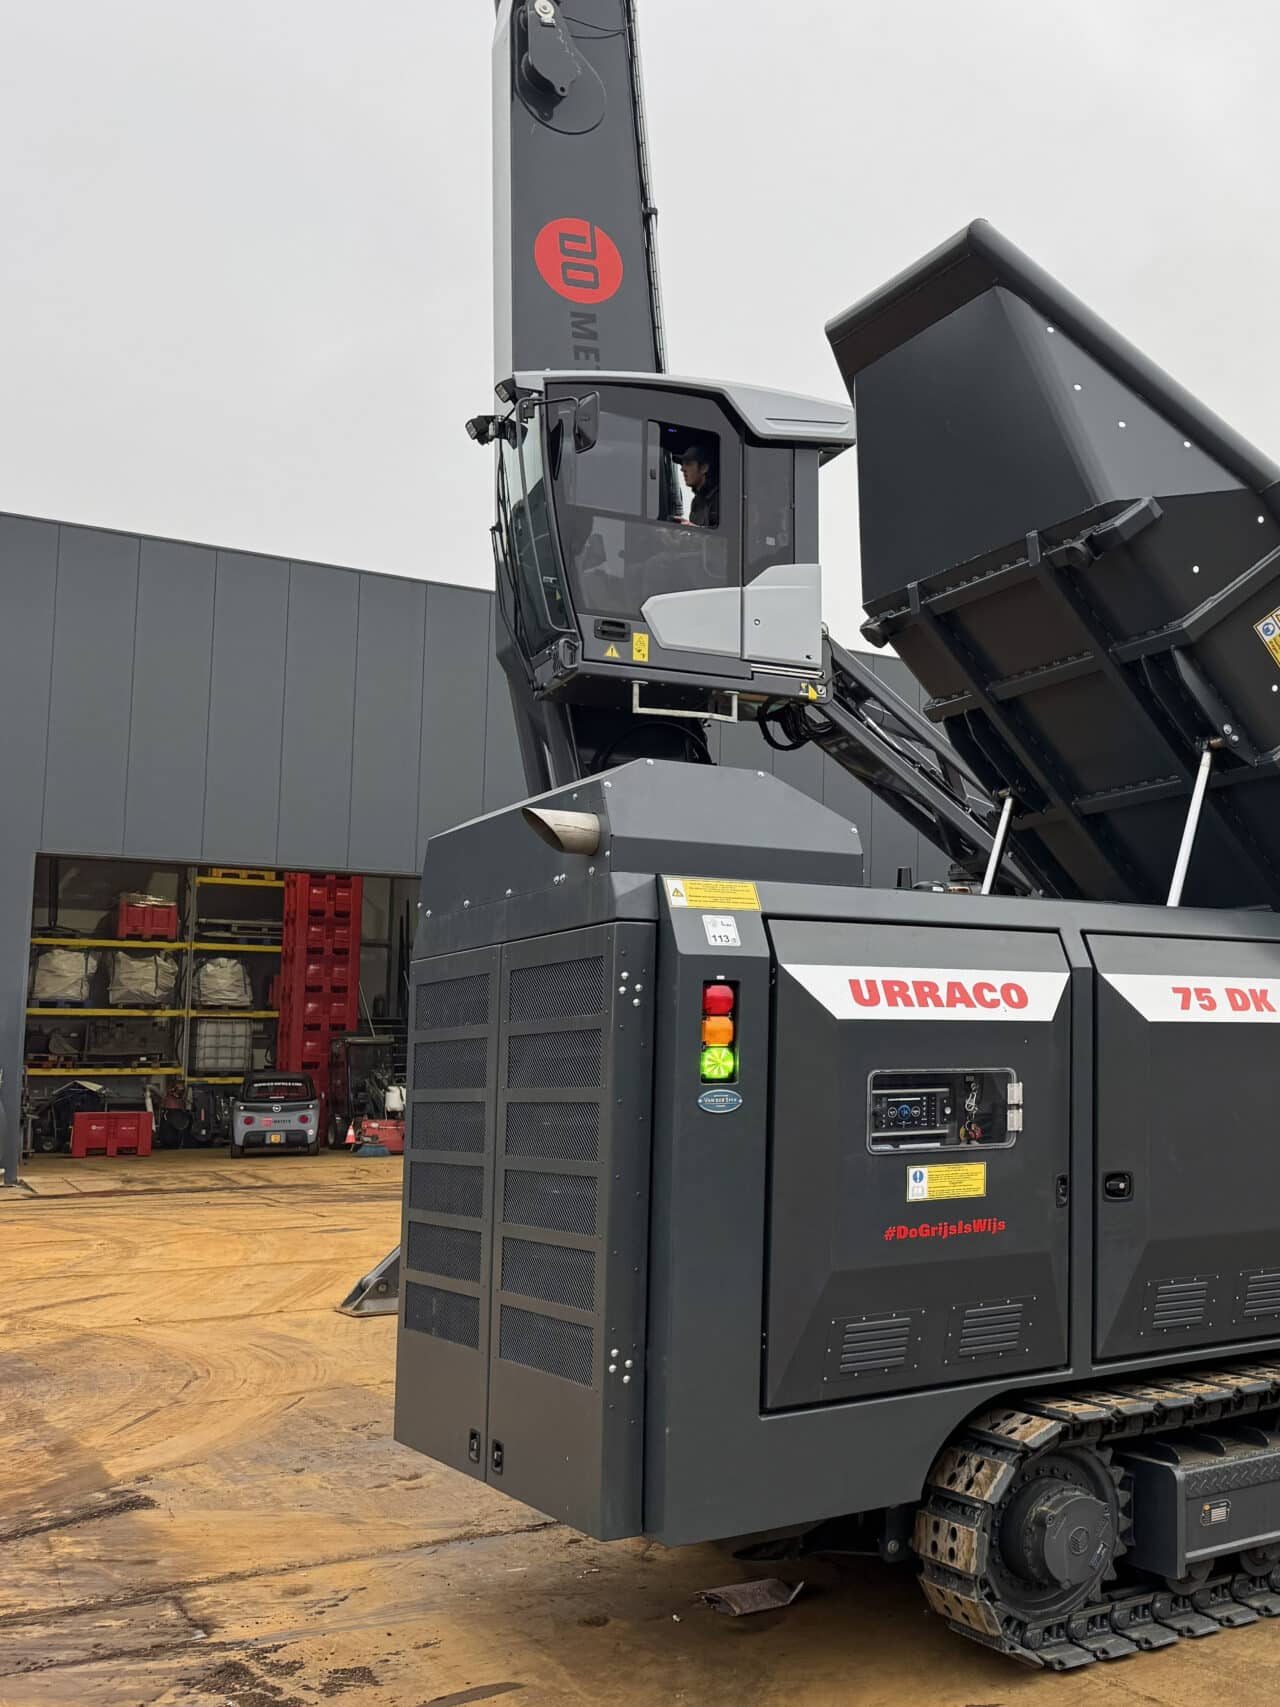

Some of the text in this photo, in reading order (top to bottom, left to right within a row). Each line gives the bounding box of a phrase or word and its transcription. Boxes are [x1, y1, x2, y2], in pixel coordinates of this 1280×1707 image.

[569, 311, 601, 370] ME
[711, 934, 730, 943] 113
[849, 978, 1029, 1010] URRACO
[1171, 987, 1277, 1013] 75 DK
[883, 1217, 1007, 1242] #DoGrijsIsWijs
